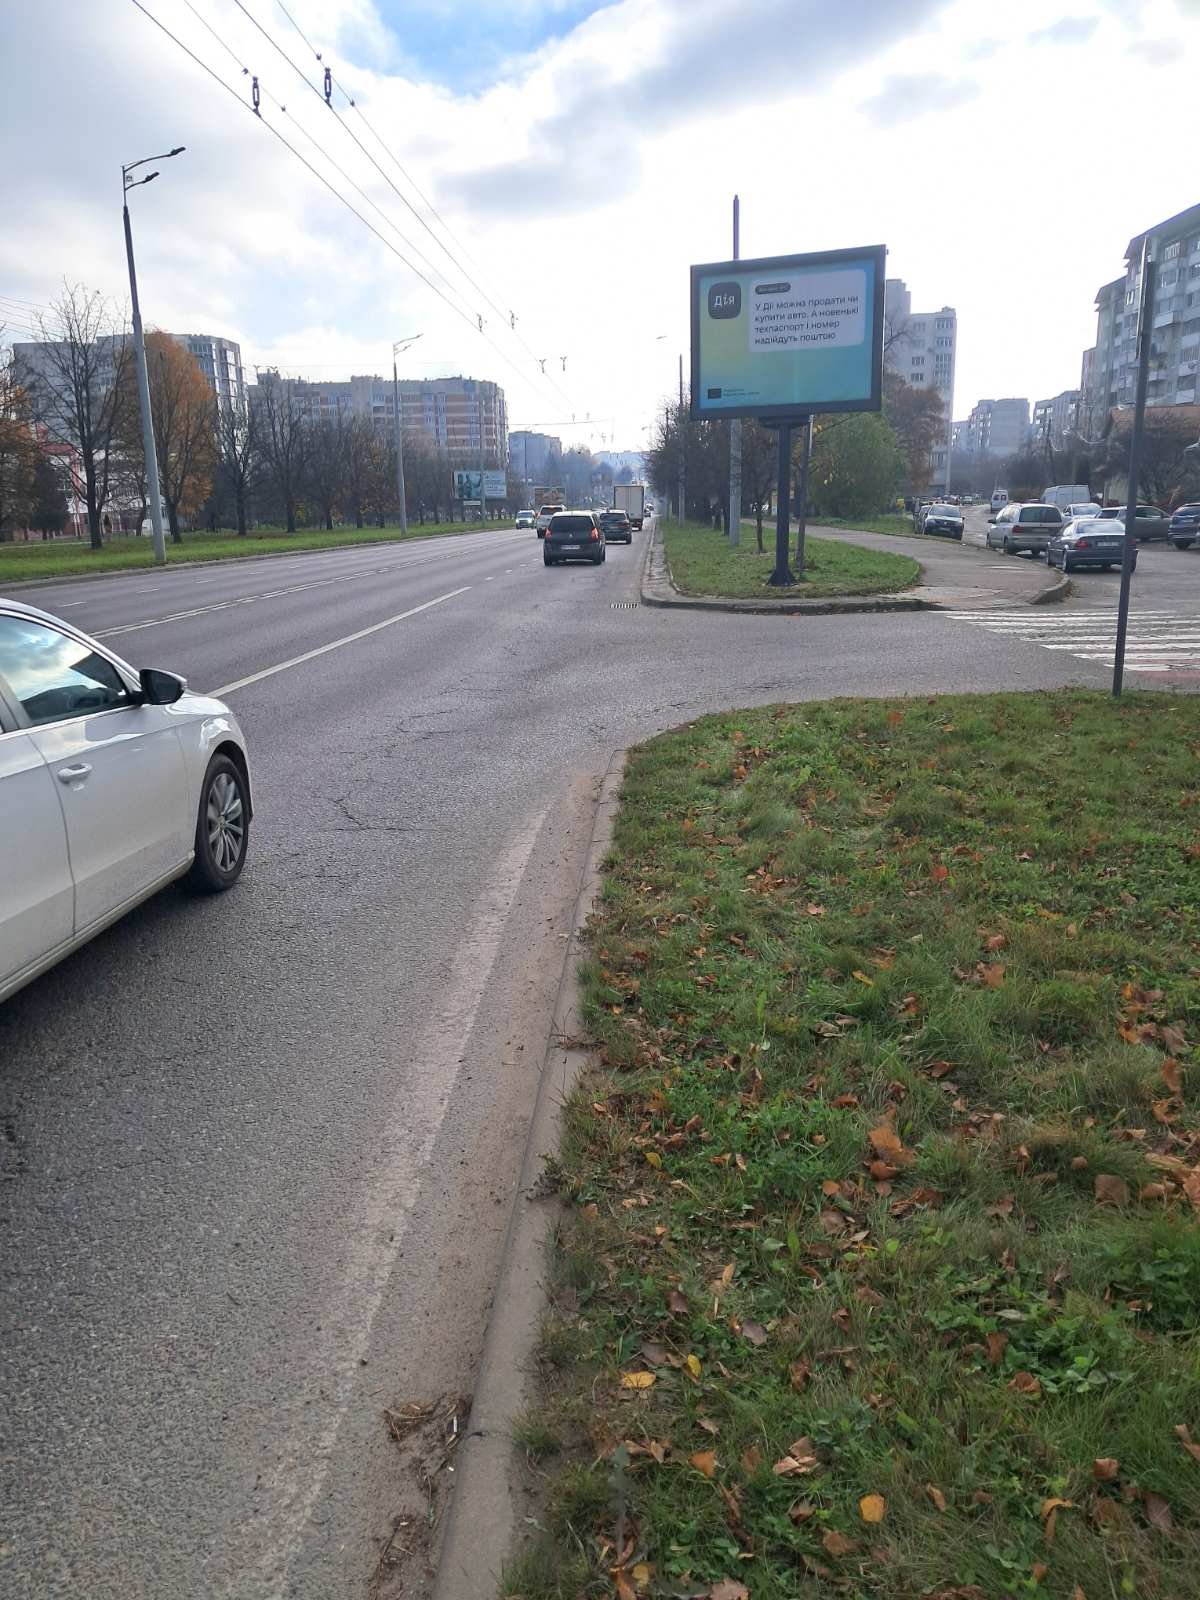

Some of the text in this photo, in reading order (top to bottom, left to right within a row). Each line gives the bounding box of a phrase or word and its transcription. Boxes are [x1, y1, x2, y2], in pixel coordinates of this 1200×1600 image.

[777, 300, 805, 309] можна
[808, 297, 845, 307] продати
[755, 313, 785, 323] купити
[819, 307, 859, 316] новенькі
[755, 323, 805, 333] техпаспорт
[811, 320, 840, 329] номер
[755, 332, 836, 344] надійдуть поштою
